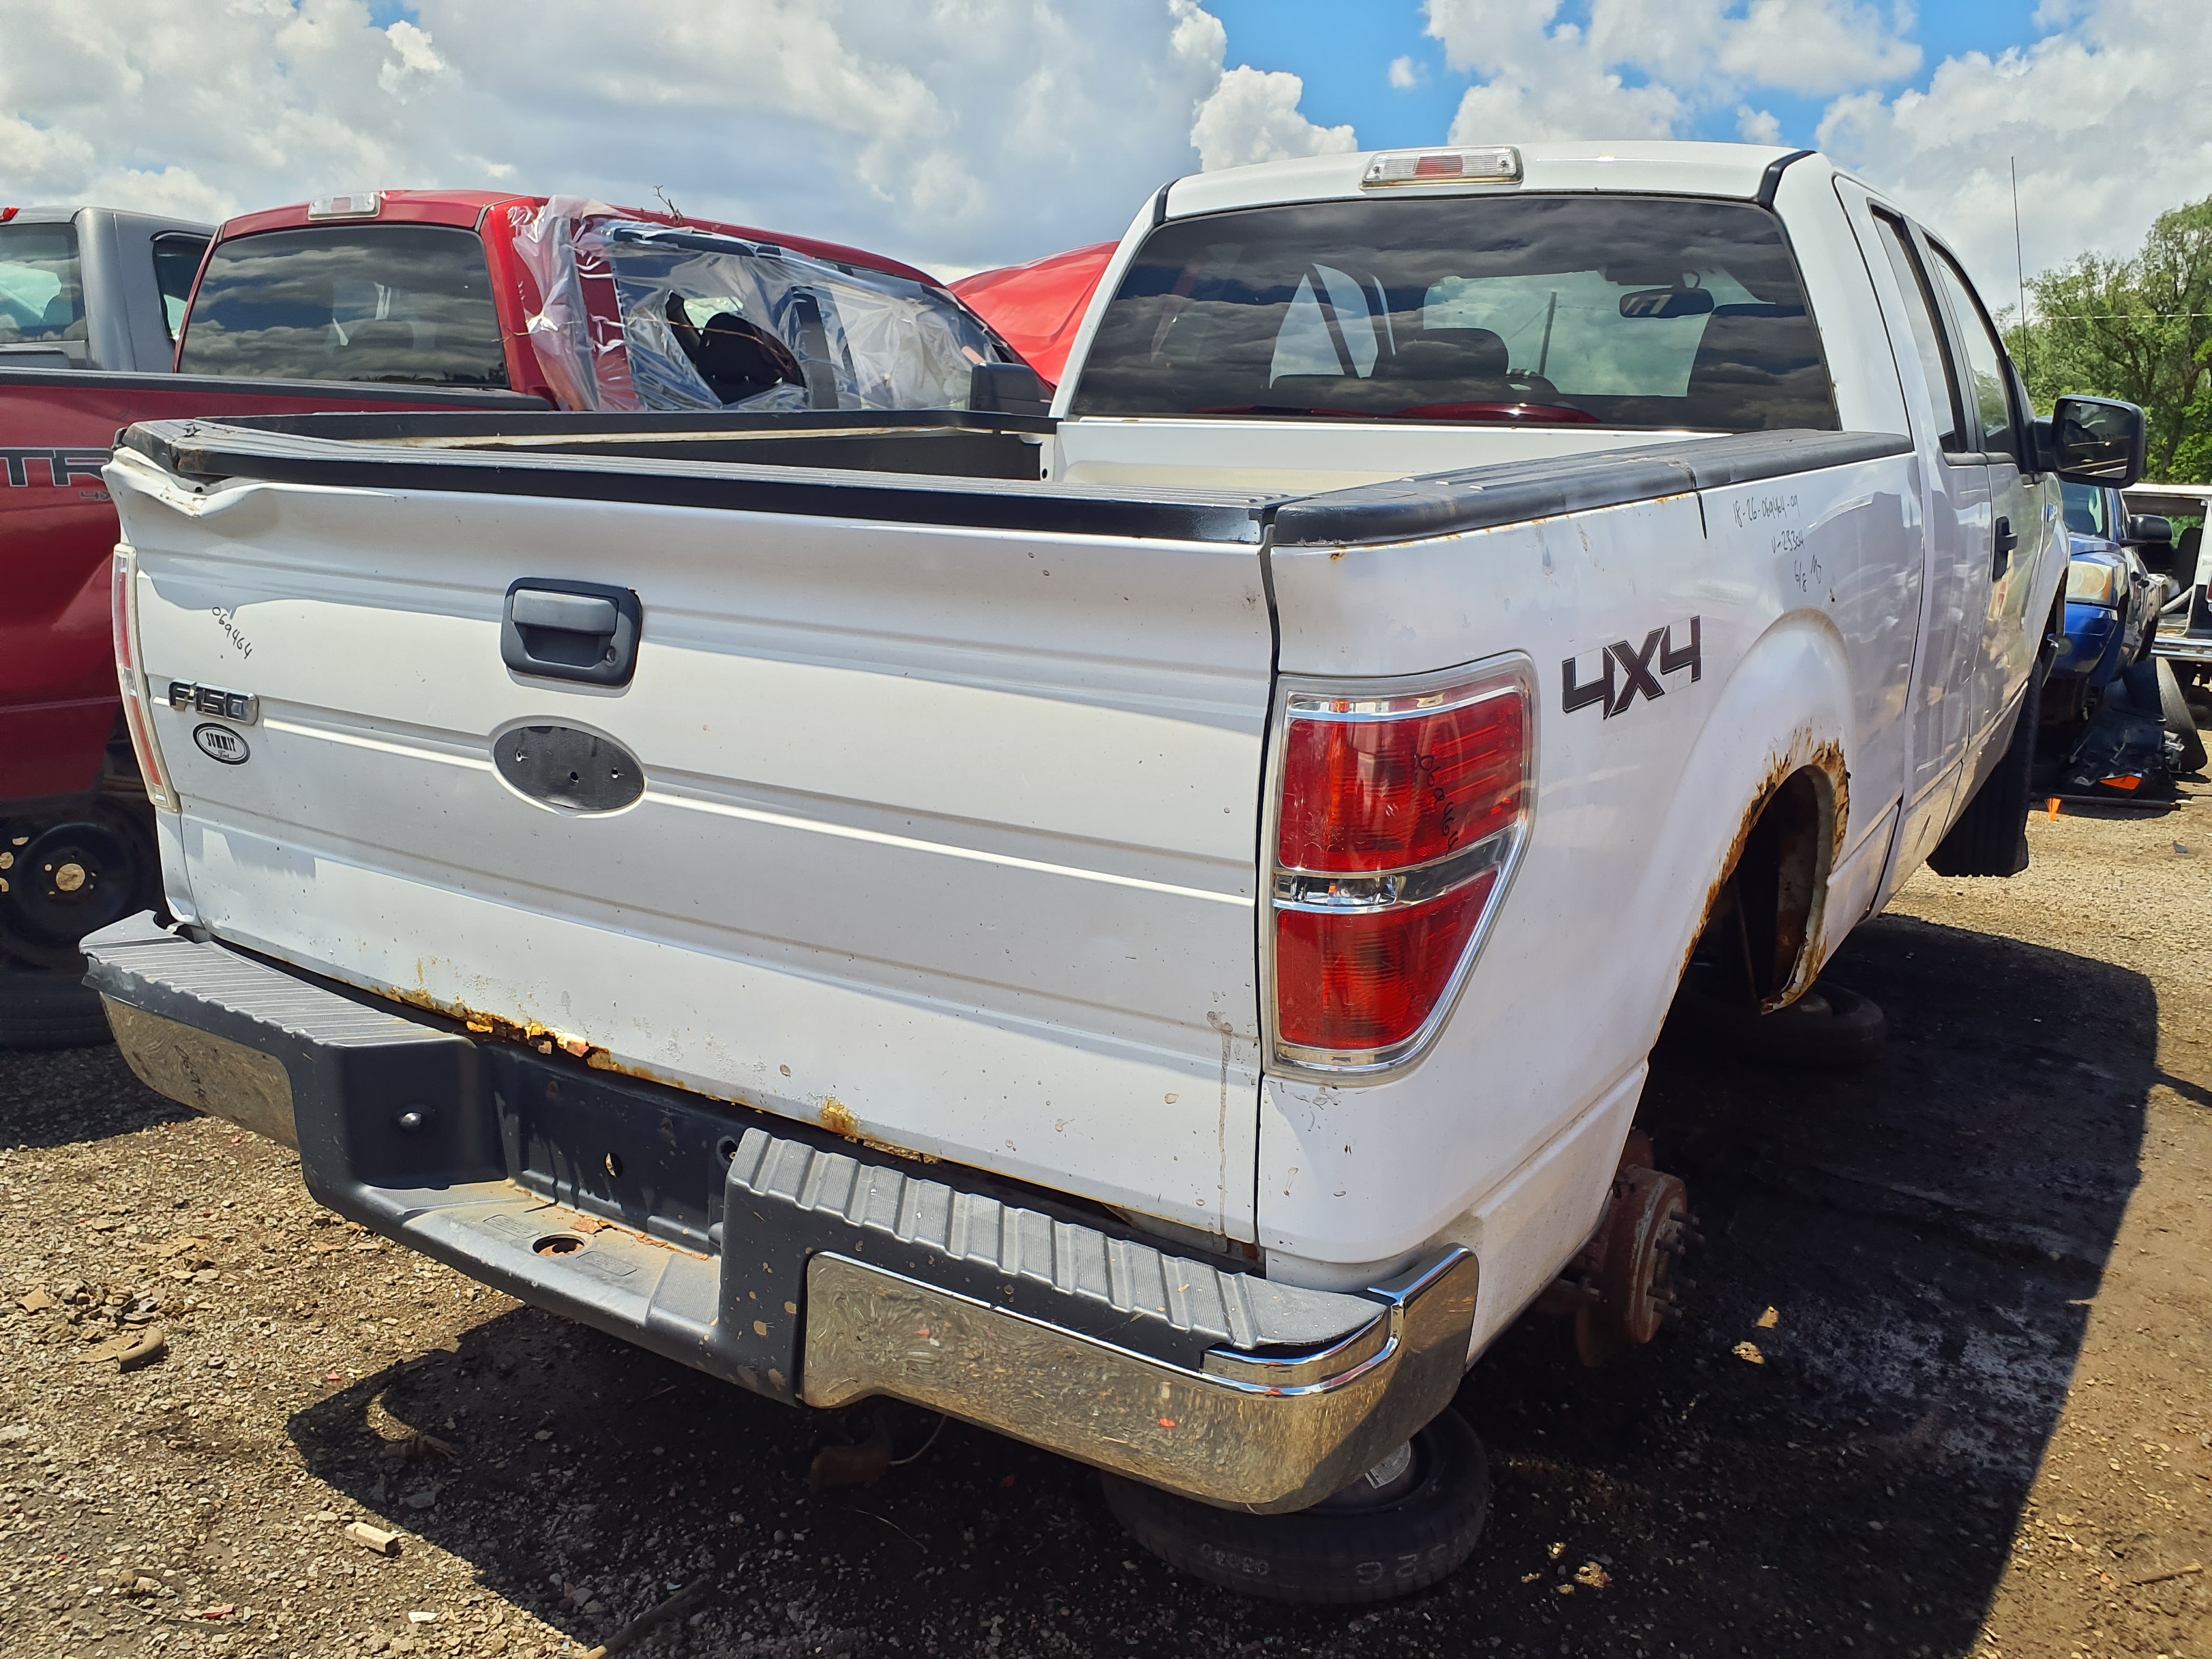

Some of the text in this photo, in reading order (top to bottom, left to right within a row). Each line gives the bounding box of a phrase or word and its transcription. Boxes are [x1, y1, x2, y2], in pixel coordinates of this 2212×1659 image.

[212, 607, 252, 660] 069464
[206, 732, 236, 752] SUMMIT
[175, 1045, 213, 1111] 06946
